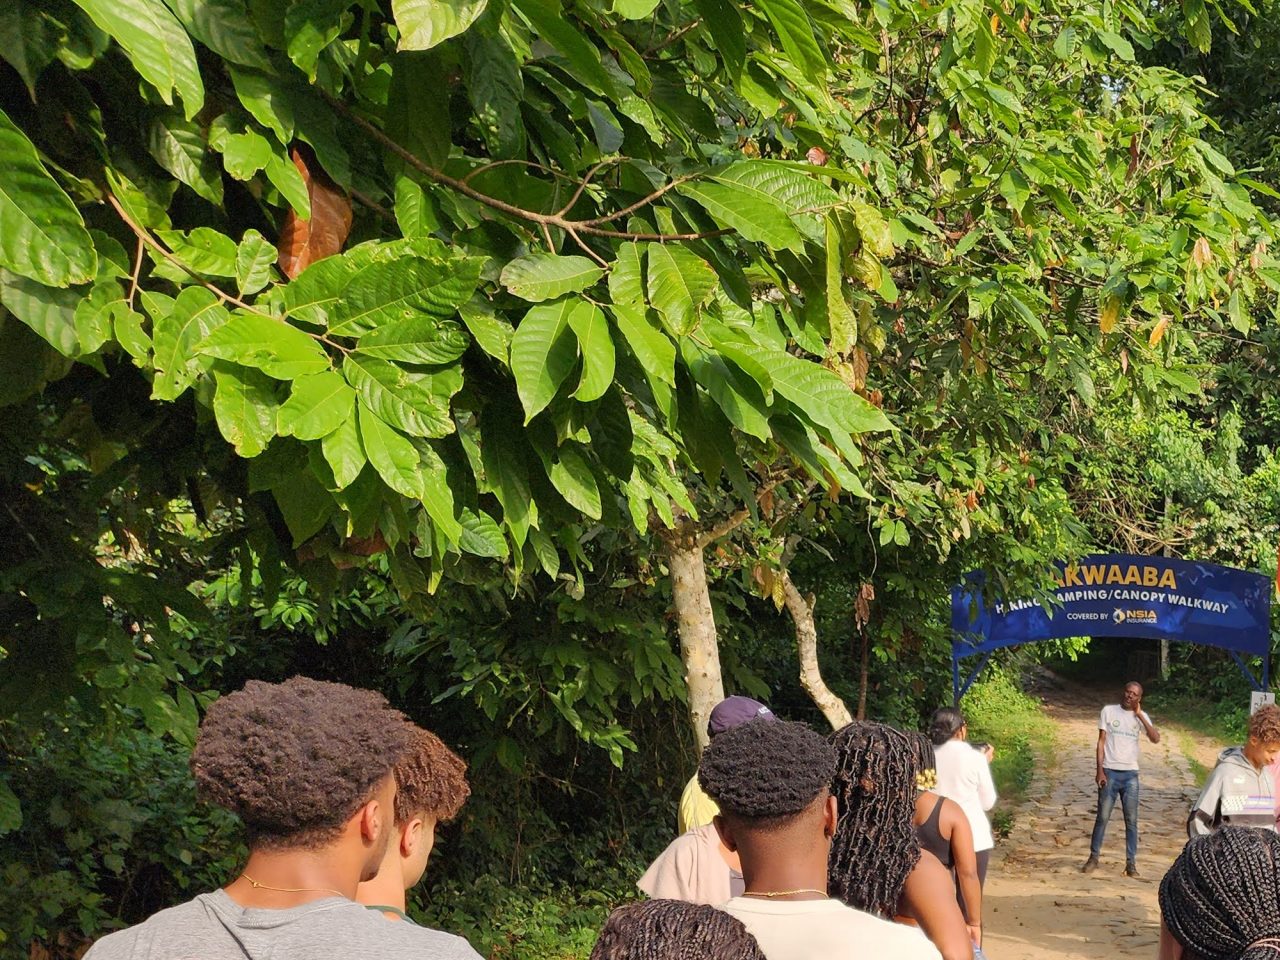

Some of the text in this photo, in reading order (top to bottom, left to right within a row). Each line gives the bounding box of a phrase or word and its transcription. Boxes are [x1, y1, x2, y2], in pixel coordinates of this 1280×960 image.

[1168, 593, 1229, 613] WALKWAY
[1066, 610, 1157, 620] COVERED BY NSIA
